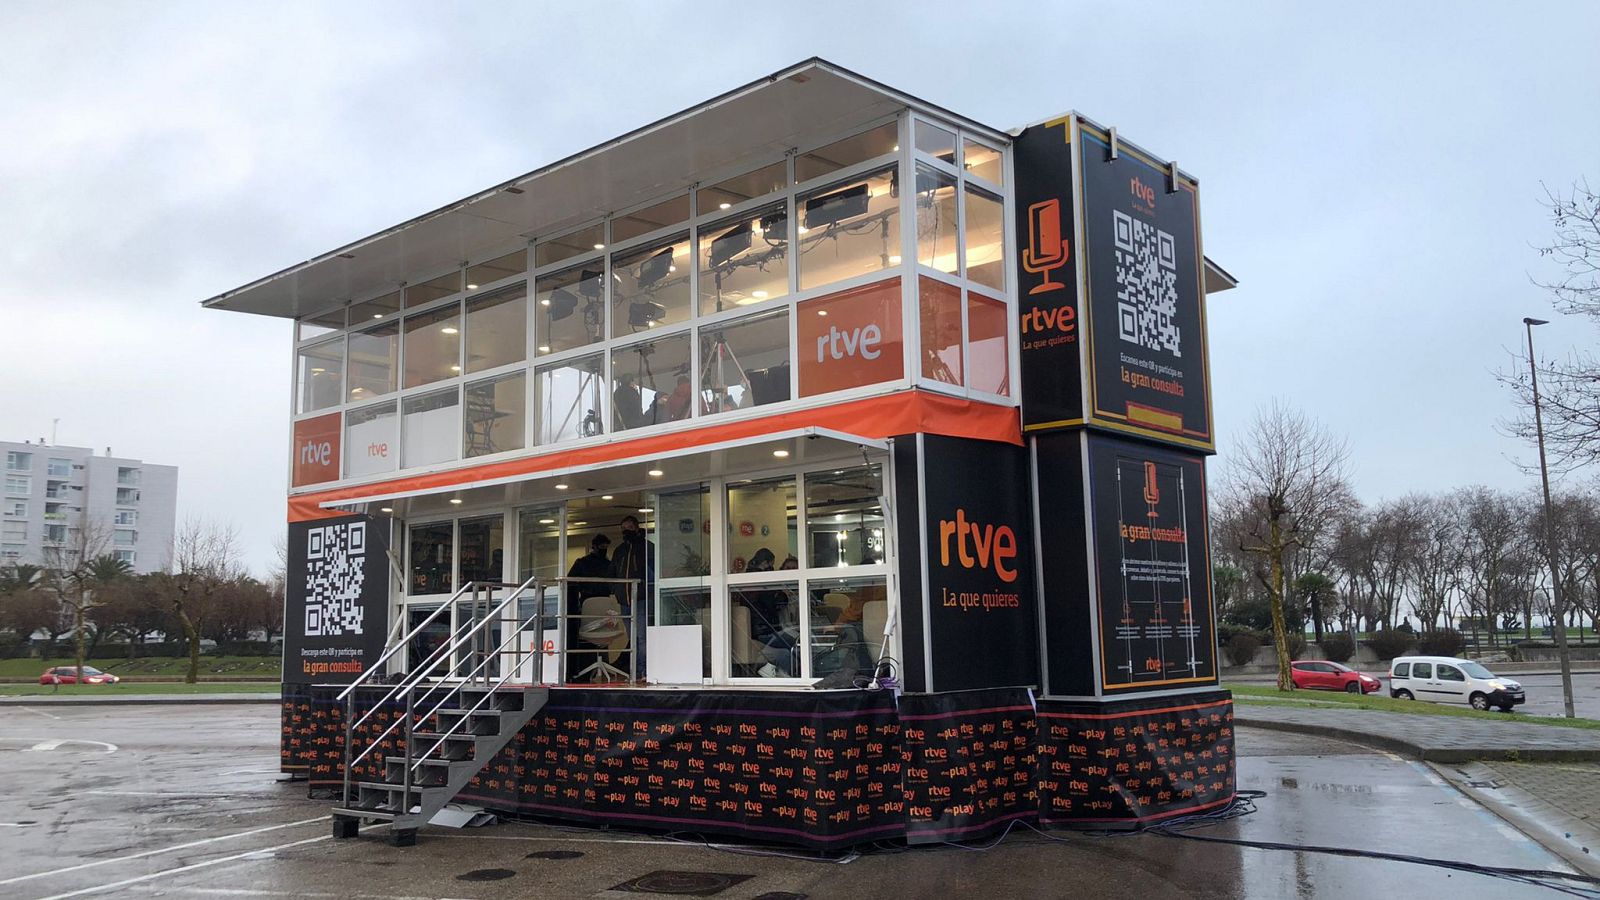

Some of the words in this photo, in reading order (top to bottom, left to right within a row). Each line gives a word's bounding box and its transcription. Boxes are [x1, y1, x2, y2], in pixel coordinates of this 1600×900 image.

[1130, 176, 1154, 208] rtve
[1022, 306, 1075, 334] rtve
[817, 324, 881, 363] rtve
[1023, 341, 1032, 350] La
[1033, 340, 1047, 349] que
[1048, 334, 1076, 346] quieres
[1120, 352, 1138, 365] Escanea
[1139, 360, 1148, 368] este
[1149, 361, 1155, 370] QR
[1155, 364, 1159, 372] y
[1159, 364, 1177, 378] participa
[1178, 370, 1183, 378] en
[1131, 372, 1150, 388] gran
[1151, 378, 1184, 396] consulta
[300, 440, 330, 466] rtve
[368, 442, 388, 457] rtve
[1129, 524, 1150, 542] gran
[940, 508, 1018, 583] rtve
[943, 588, 956, 606] La
[960, 592, 980, 611] que
[982, 589, 1018, 612] quieres
[301, 648, 318, 657] Descarga
[338, 647, 356, 657] participa
[311, 662, 328, 675] gran
[330, 659, 362, 672] consulta
[1146, 657, 1161, 672] rtve
[585, 719, 597, 729] rtve
[610, 722, 624, 732] play
[633, 721, 648, 731] rtve
[660, 724, 675, 734] play
[684, 723, 700, 732] rtve
[716, 725, 731, 734] play
[740, 724, 756, 735] rtve
[772, 728, 789, 738] play
[801, 727, 815, 737] rtve
[833, 730, 847, 740] play
[856, 725, 868, 734] rtve
[884, 726, 899, 735] play
[906, 729, 924, 740] rtve
[961, 723, 973, 734] rtve
[983, 724, 995, 734] play
[1051, 727, 1067, 736] rtve
[1086, 730, 1105, 740] play
[557, 735, 568, 744] rtve
[579, 738, 590, 748] play
[596, 738, 609, 747] rtve
[621, 741, 636, 751] play
[645, 740, 659, 749] rtve
[677, 742, 692, 752] play
[703, 740, 717, 751] rtve
[732, 745, 745, 756] play
[757, 744, 773, 755] rtve
[791, 749, 807, 760] play
[815, 748, 833, 759] rtve
[847, 748, 859, 759] play
[867, 743, 882, 752] rtve
[925, 748, 946, 758] rtve
[994, 740, 1008, 750] play
[1014, 736, 1026, 745] rtve
[1038, 745, 1056, 756] play
[1069, 745, 1086, 754] rtve
[1105, 748, 1120, 758] play
[546, 751, 556, 760] rtve
[584, 753, 595, 764] rtve
[608, 758, 622, 768] play
[632, 757, 648, 767] rtve
[663, 760, 678, 770] play
[689, 759, 704, 769] rtve
[719, 763, 734, 773] play
[742, 763, 759, 774] rtve
[776, 768, 793, 779] play
[803, 768, 816, 779] rtve
[835, 771, 848, 781] play
[857, 765, 868, 774] rtve
[882, 764, 900, 774] play
[908, 768, 928, 779] rtve
[950, 767, 967, 779] play
[1053, 762, 1070, 772] rtve
[1087, 766, 1107, 776] play
[557, 769, 567, 777] rtve
[594, 772, 608, 782] rtve
[624, 775, 639, 786] play
[649, 775, 663, 785] rtve
[678, 778, 694, 789] play
[704, 779, 720, 788] rtve
[735, 783, 748, 794] play
[760, 783, 776, 794] rtve
[794, 789, 808, 800] play
[816, 790, 834, 800] rtve
[869, 784, 882, 792] rtve
[929, 786, 950, 797] rtve
[996, 777, 1008, 787] play
[1014, 771, 1027, 781] rtve
[1039, 782, 1057, 791] play
[1070, 781, 1088, 791] rtve
[545, 785, 557, 793] rtve
[566, 788, 579, 799] play
[610, 793, 625, 803] play
[635, 792, 650, 802] rtve
[664, 797, 679, 806] play
[690, 796, 706, 807] rtve
[722, 801, 737, 811] play
[745, 801, 762, 812] rtve
[779, 807, 796, 817] play
[804, 808, 817, 820] rtve
[836, 811, 850, 823] play
[857, 805, 869, 814] rtve
[884, 803, 903, 814] play
[910, 807, 931, 817] rtve
[953, 805, 974, 817] play
[1054, 797, 1071, 807] rtve
[1092, 800, 1112, 810] play
